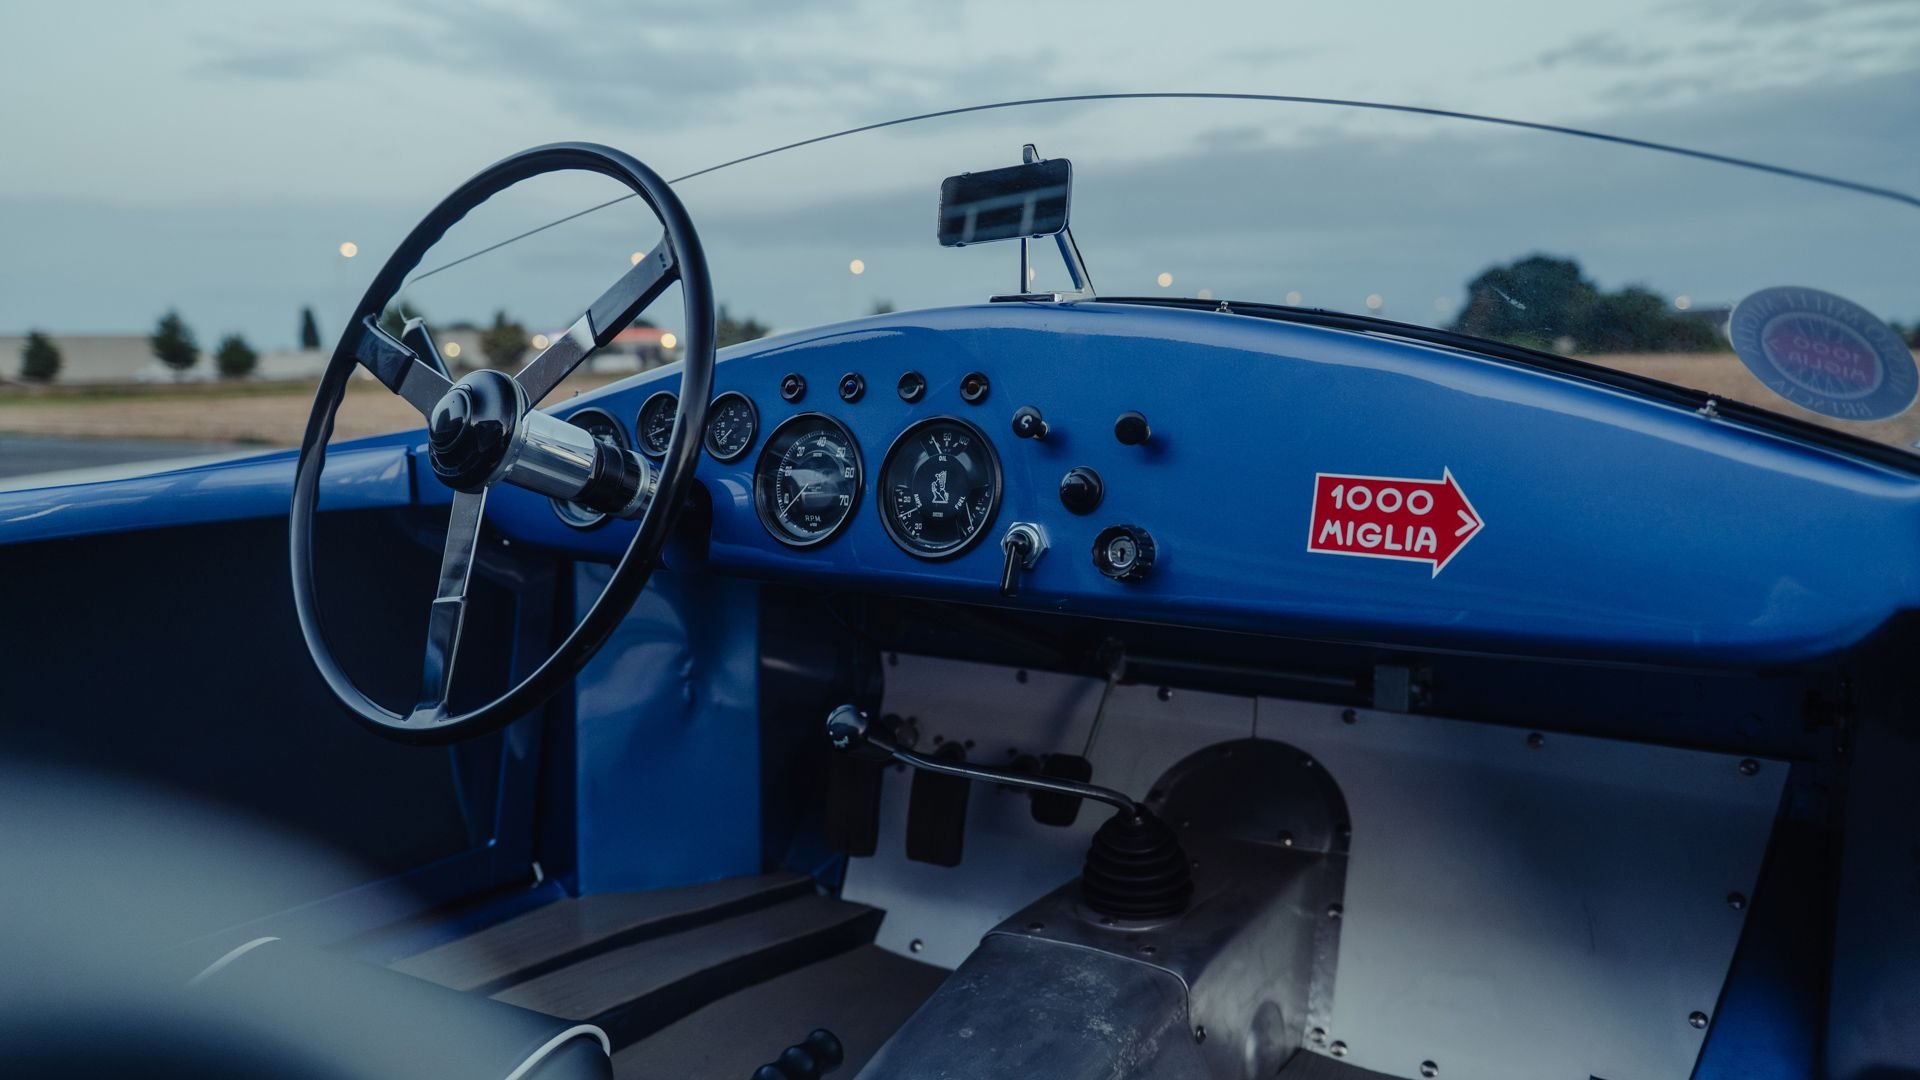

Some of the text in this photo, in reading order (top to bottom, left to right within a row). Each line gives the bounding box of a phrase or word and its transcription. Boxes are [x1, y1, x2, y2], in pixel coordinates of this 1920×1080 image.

[835, 446, 847, 458] 50
[844, 467, 855, 478] 60
[839, 495, 849, 507] 70
[1330, 484, 1434, 515] 1000
[914, 522, 923, 530] 30
[1318, 519, 1437, 554] MIGLIA
